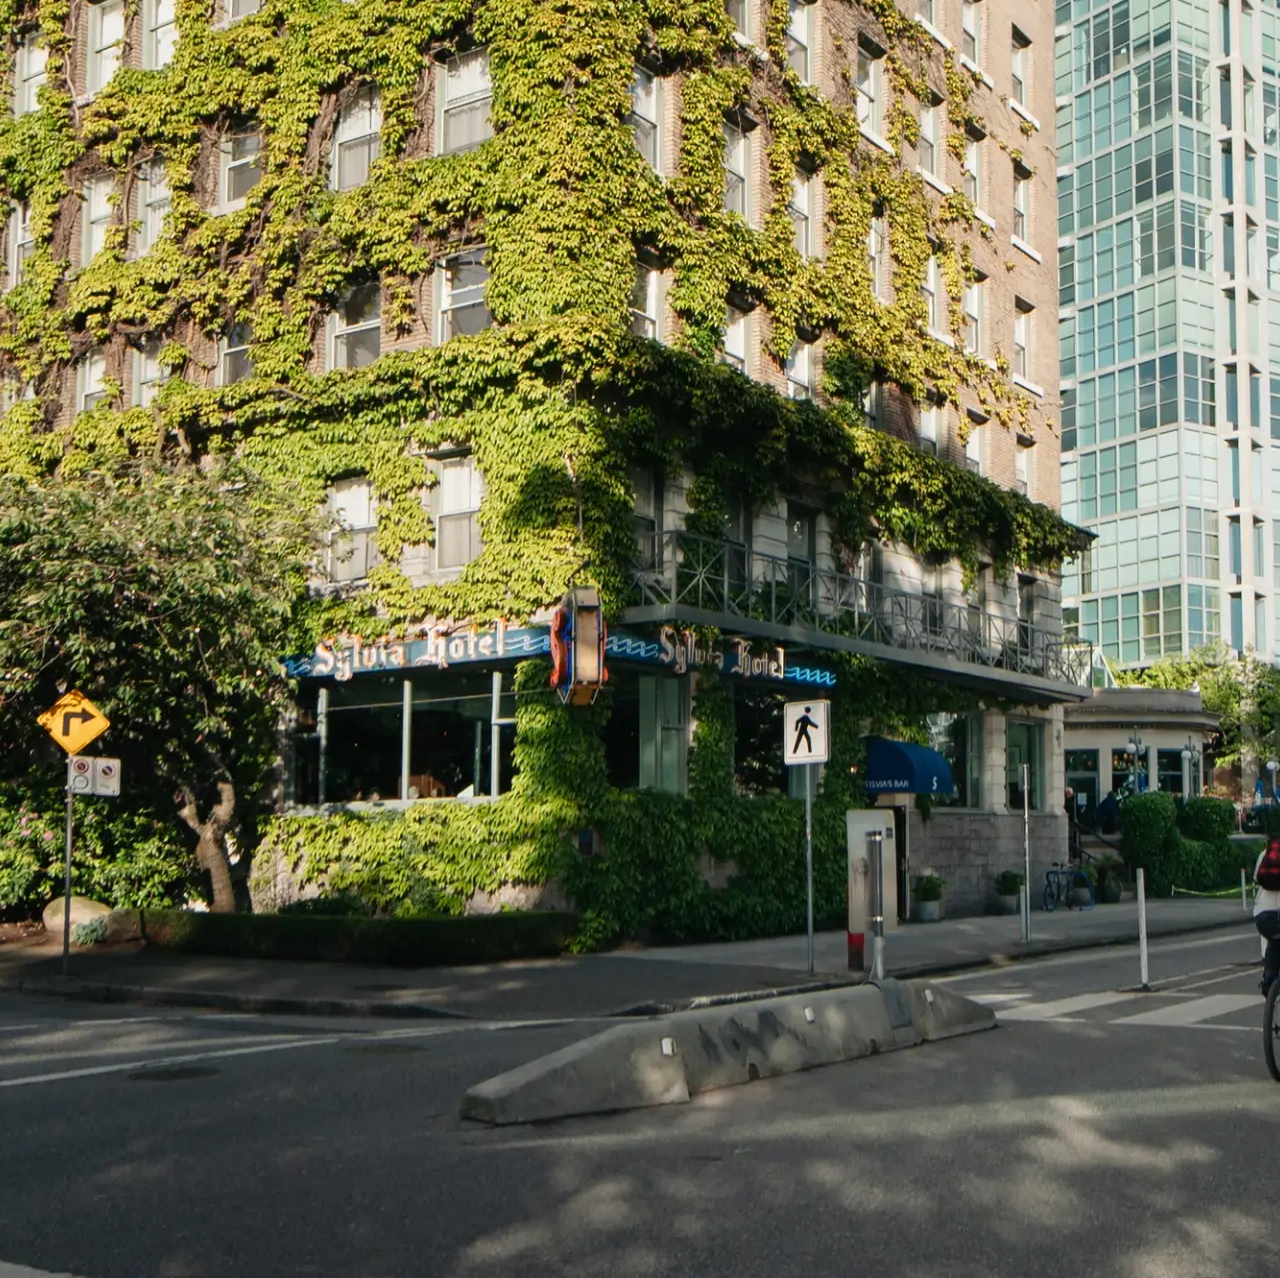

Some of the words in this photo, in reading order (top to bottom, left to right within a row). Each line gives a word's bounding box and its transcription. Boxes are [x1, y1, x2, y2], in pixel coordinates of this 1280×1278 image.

[313, 634, 406, 681] Sylvia
[415, 617, 507, 669] Hotel
[731, 638, 785, 679] Hotel
[894, 780, 909, 788] BAR
